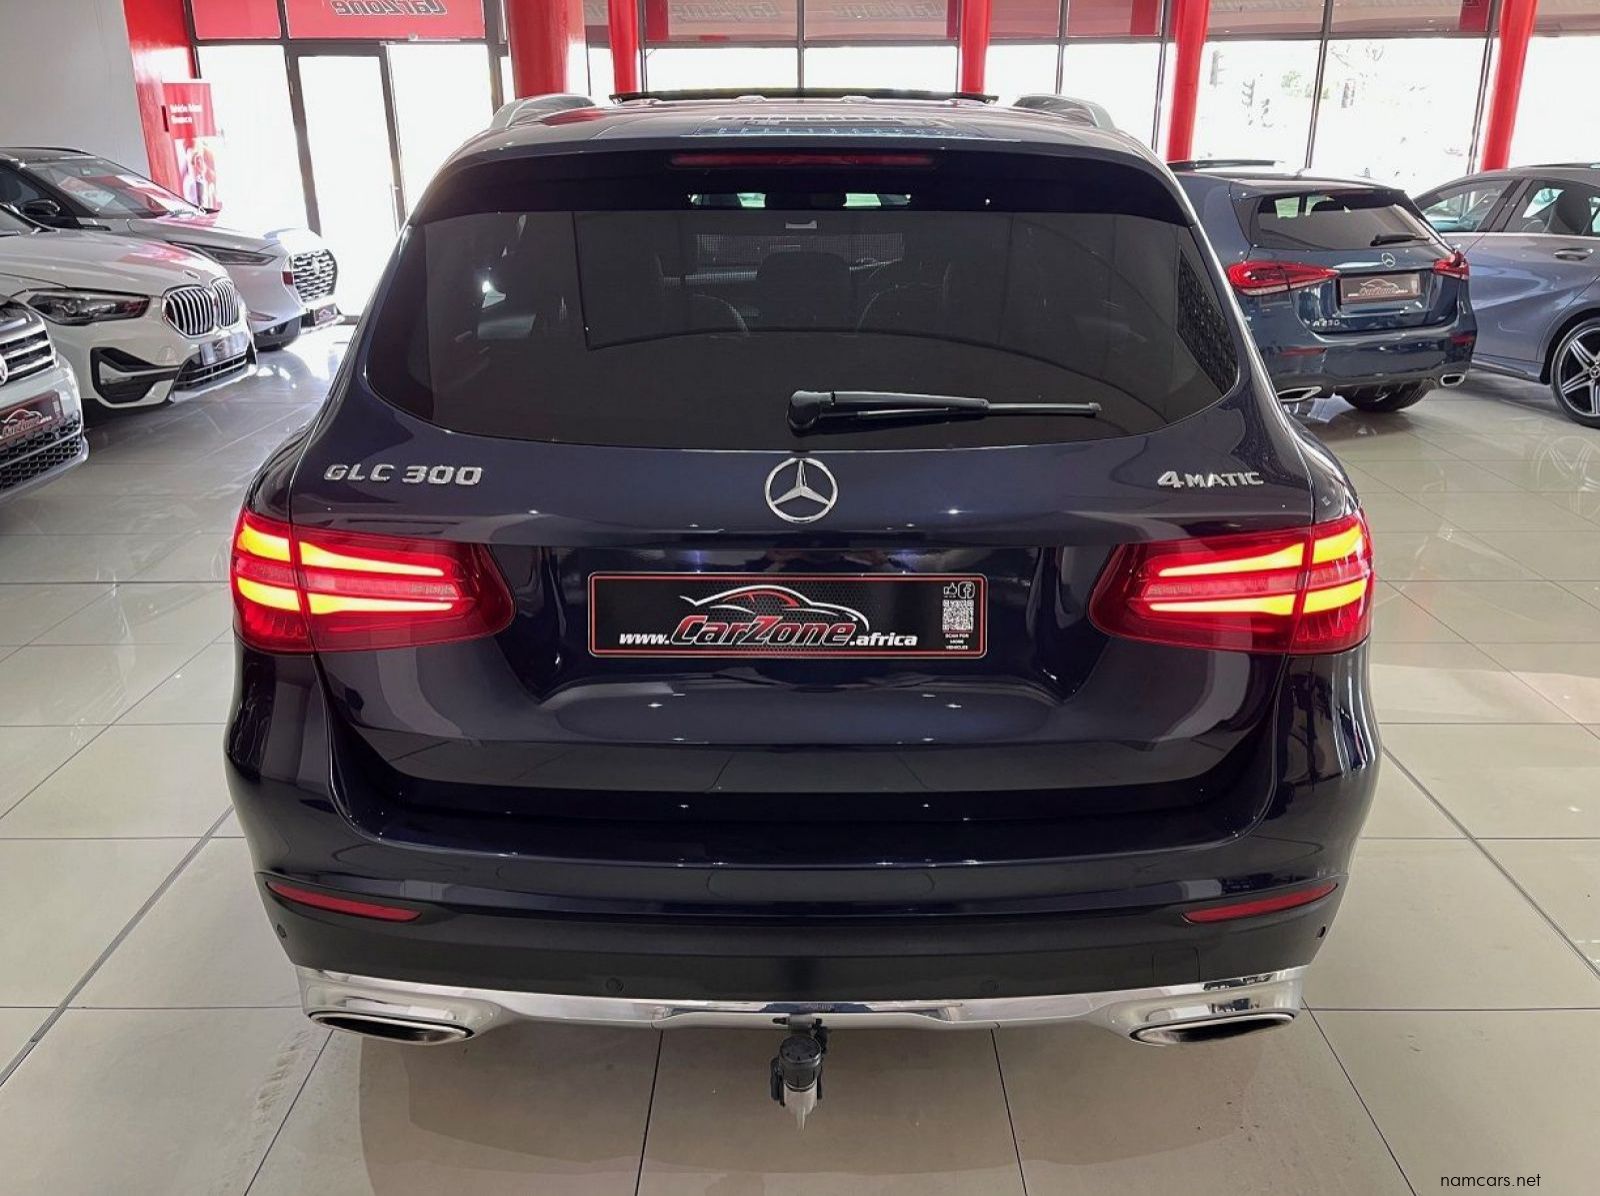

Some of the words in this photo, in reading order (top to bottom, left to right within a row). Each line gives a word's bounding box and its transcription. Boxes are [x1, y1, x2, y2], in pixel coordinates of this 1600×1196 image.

[324, 464, 395, 481] GLC
[402, 465, 483, 485] 300
[1157, 470, 1264, 488] 4MATIC
